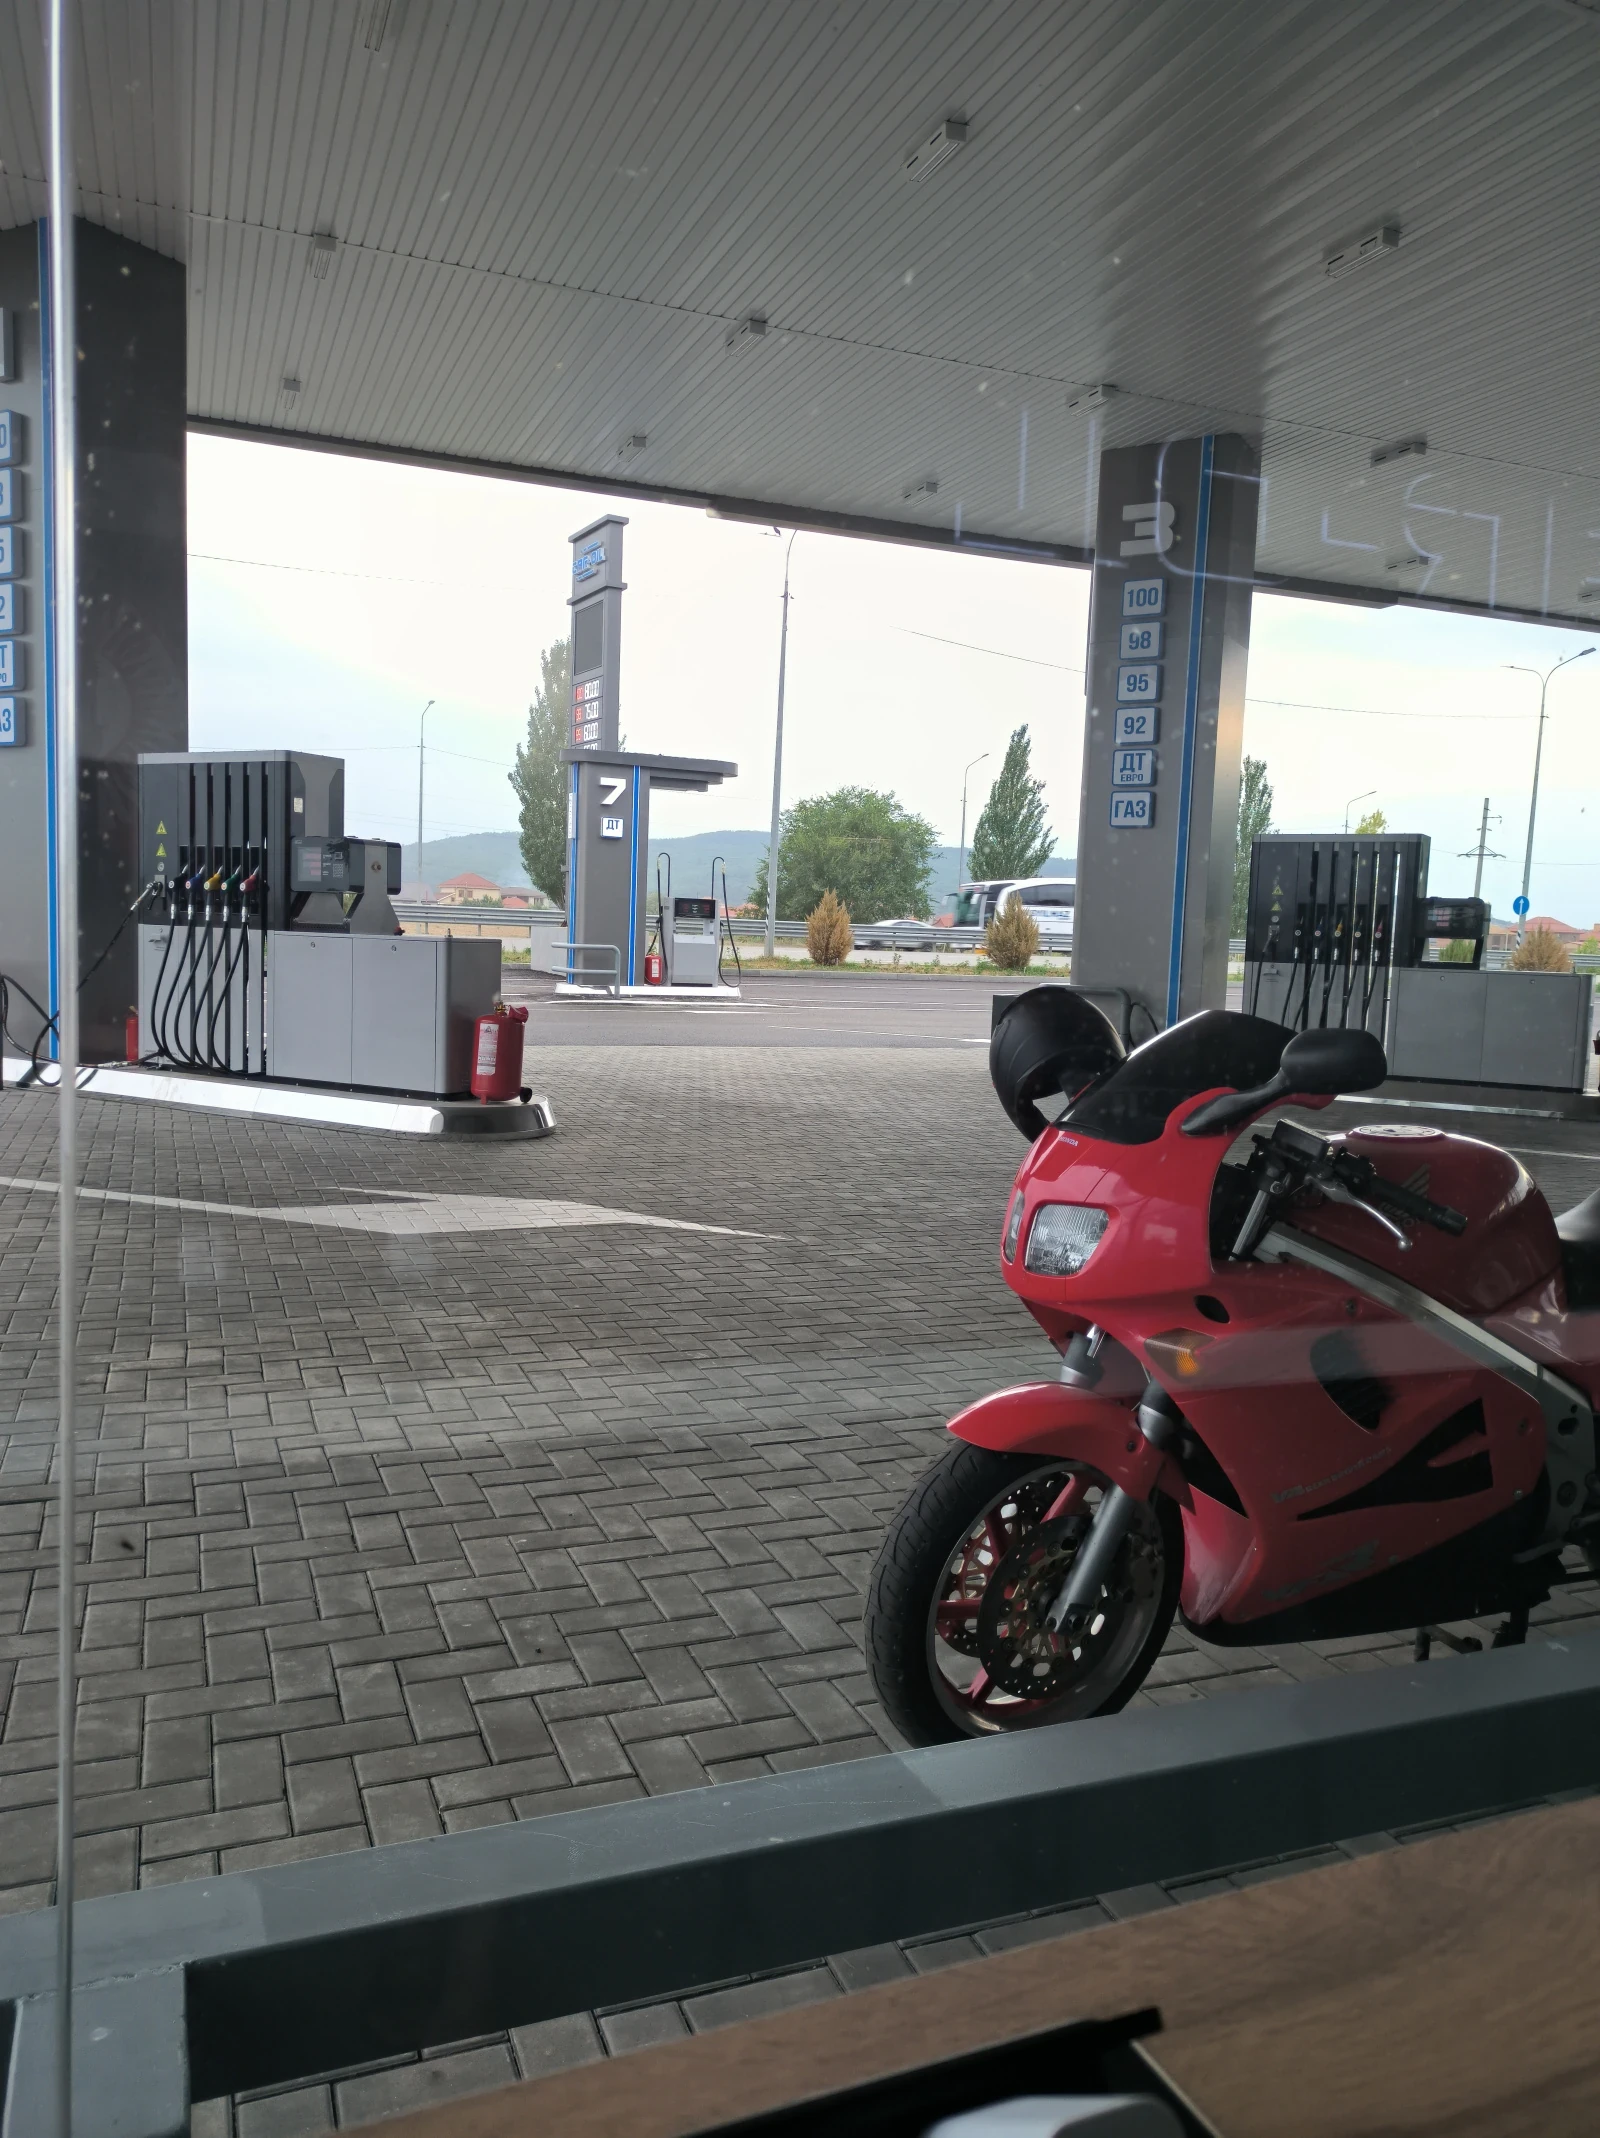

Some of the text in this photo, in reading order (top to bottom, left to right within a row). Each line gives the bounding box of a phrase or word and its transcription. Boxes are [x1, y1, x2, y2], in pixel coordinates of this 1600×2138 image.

[1120, 501, 1176, 557] 3
[1127, 587, 1159, 607] 100
[1128, 630, 1152, 650] 98
[1126, 673, 1150, 692] 95
[1123, 716, 1147, 735] 92
[1119, 753, 1145, 773] ДТ
[1120, 773, 1144, 782] ЕВРО
[600, 777, 626, 805] 7
[1114, 800, 1146, 819] ГАЗ
[606, 820, 620, 831] ДТ
